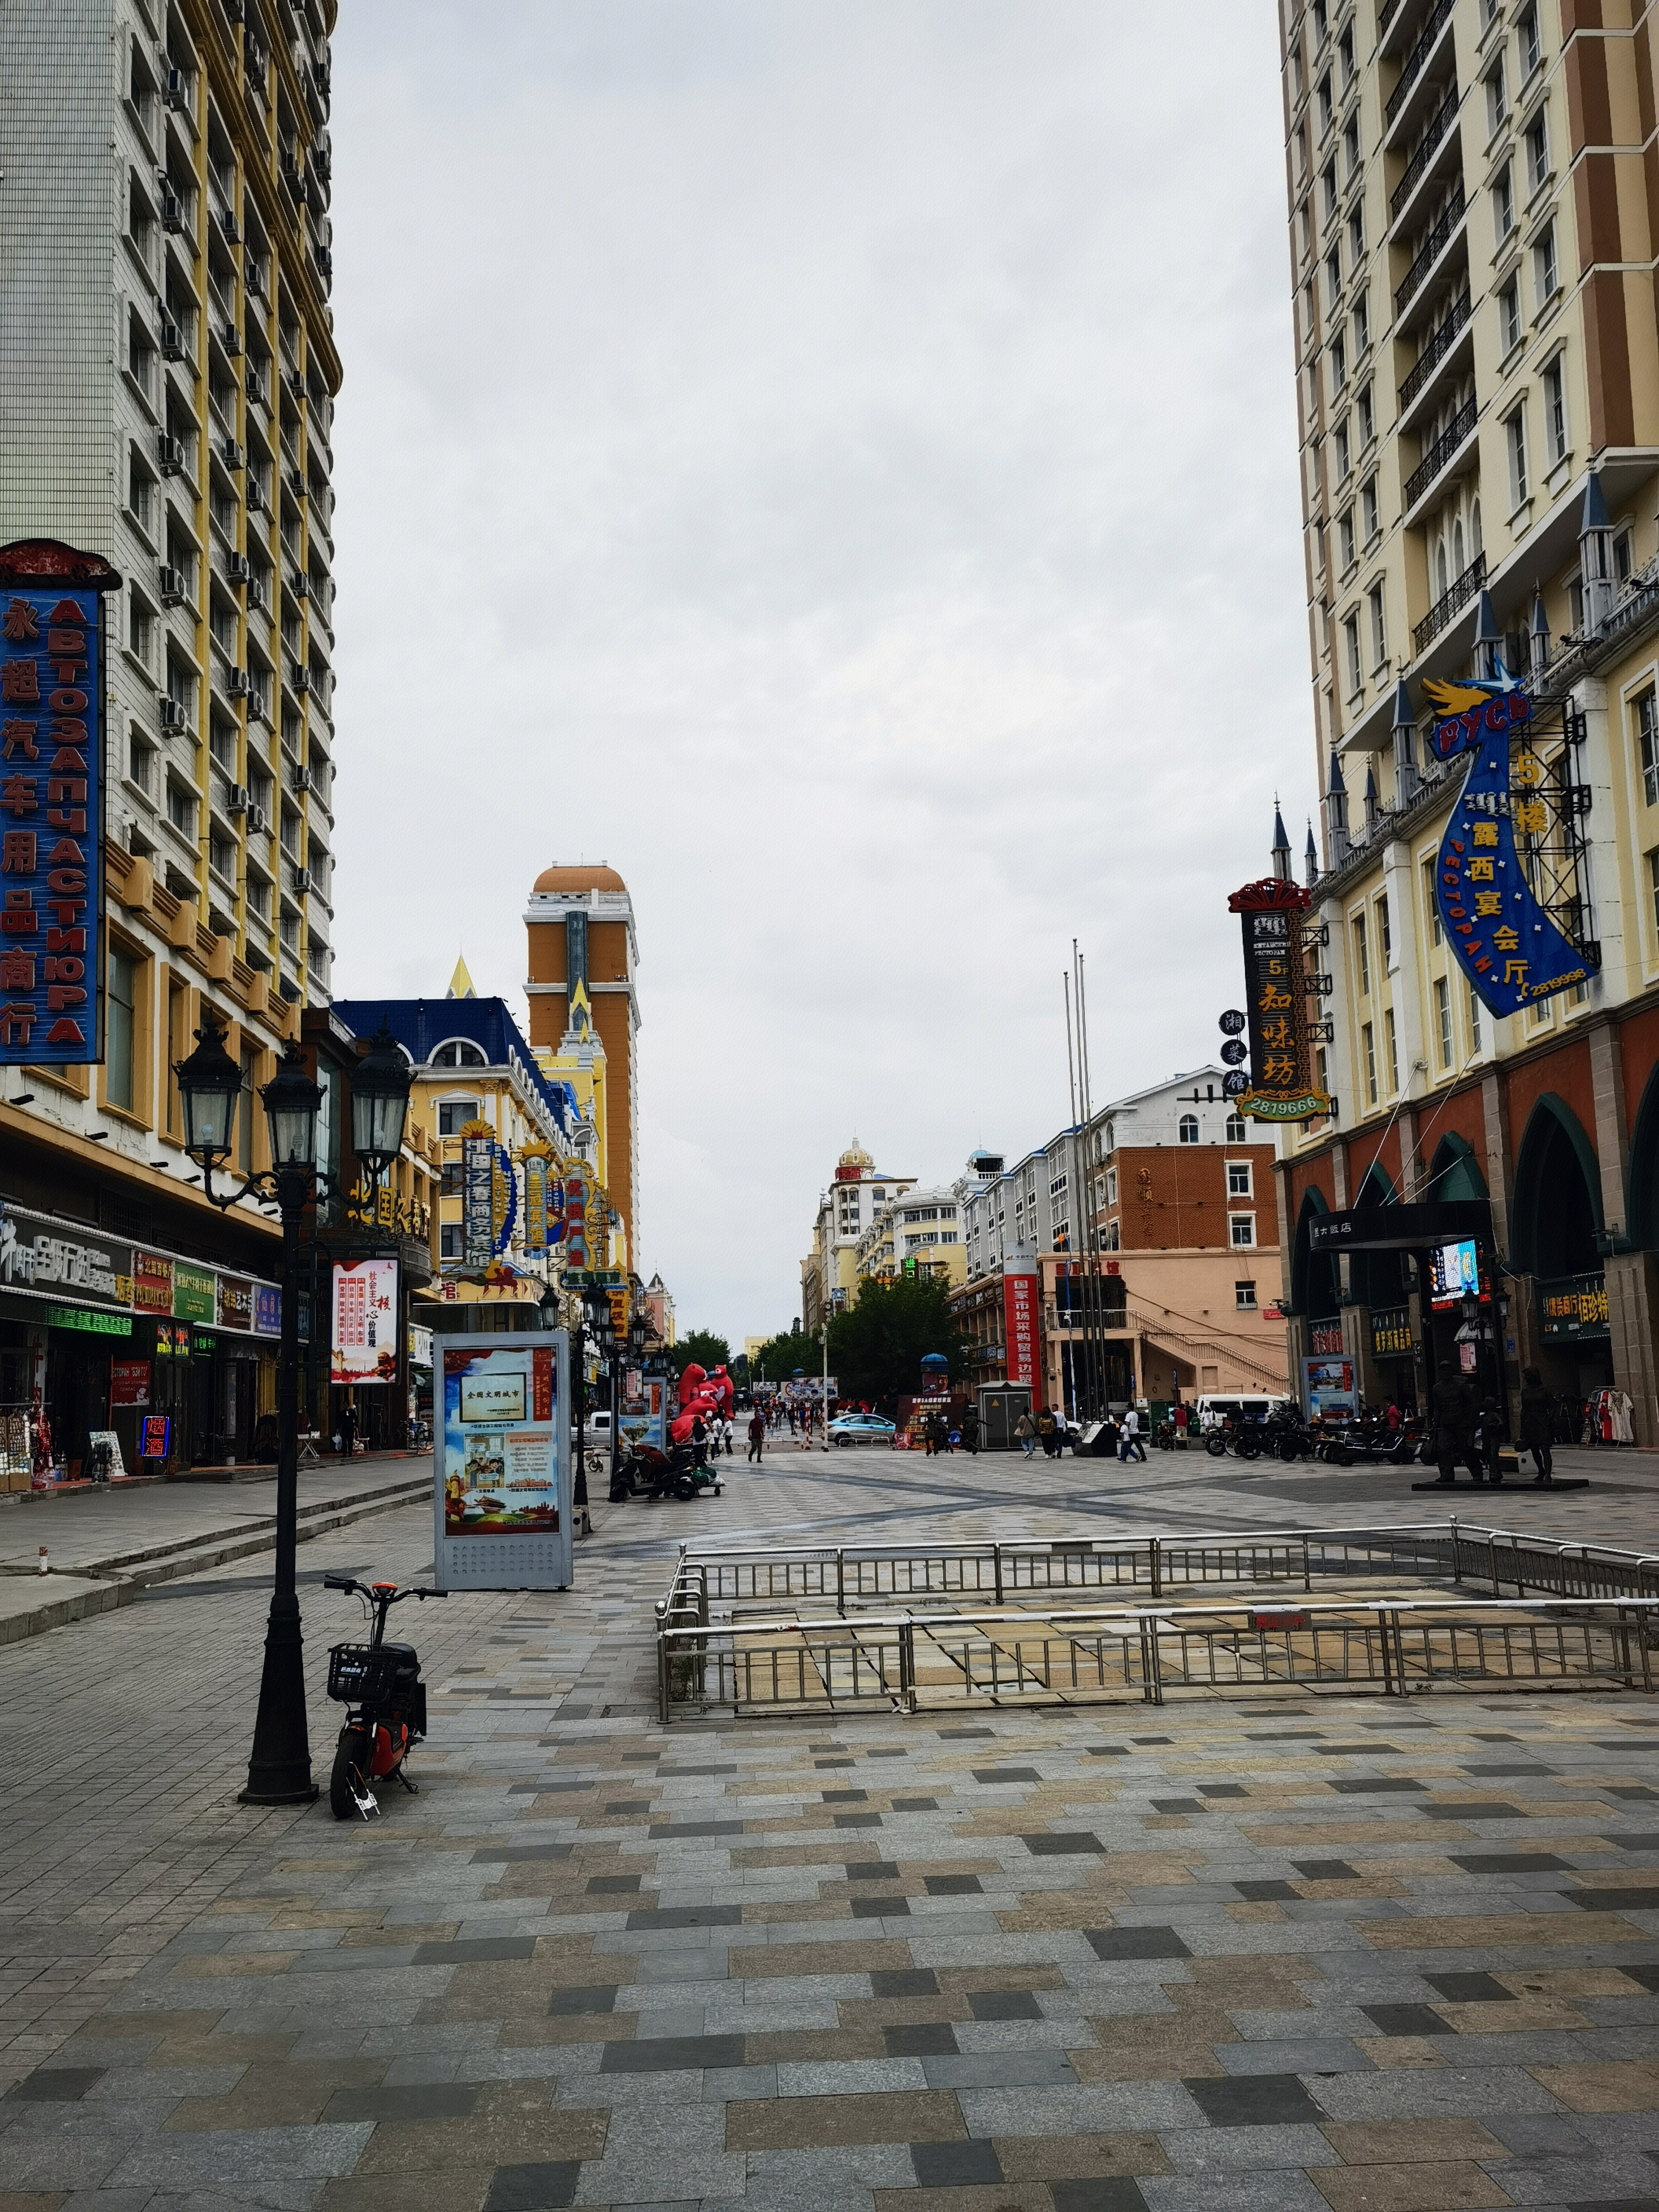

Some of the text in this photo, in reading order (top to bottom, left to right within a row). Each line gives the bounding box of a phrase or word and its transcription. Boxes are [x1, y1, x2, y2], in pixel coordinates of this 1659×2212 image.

[0, 597, 40, 1046] 永超汽车用品商行
[1443, 838, 1495, 974] РЕСТОРАН
[1468, 821, 1532, 986] 露西宴会厅
[1224, 1013, 1245, 1090] 湘菜馆
[1258, 982, 1296, 1085] 知味坊
[1250, 1095, 1317, 1115] 2819666
[471, 1138, 493, 1267] 北国之春商务宾馆
[1013, 1279, 1033, 1384] 国家市场采购贸易边贸
[146, 1417, 166, 1455] 烟酒
[467, 1389, 520, 1400] 全国文明城市
